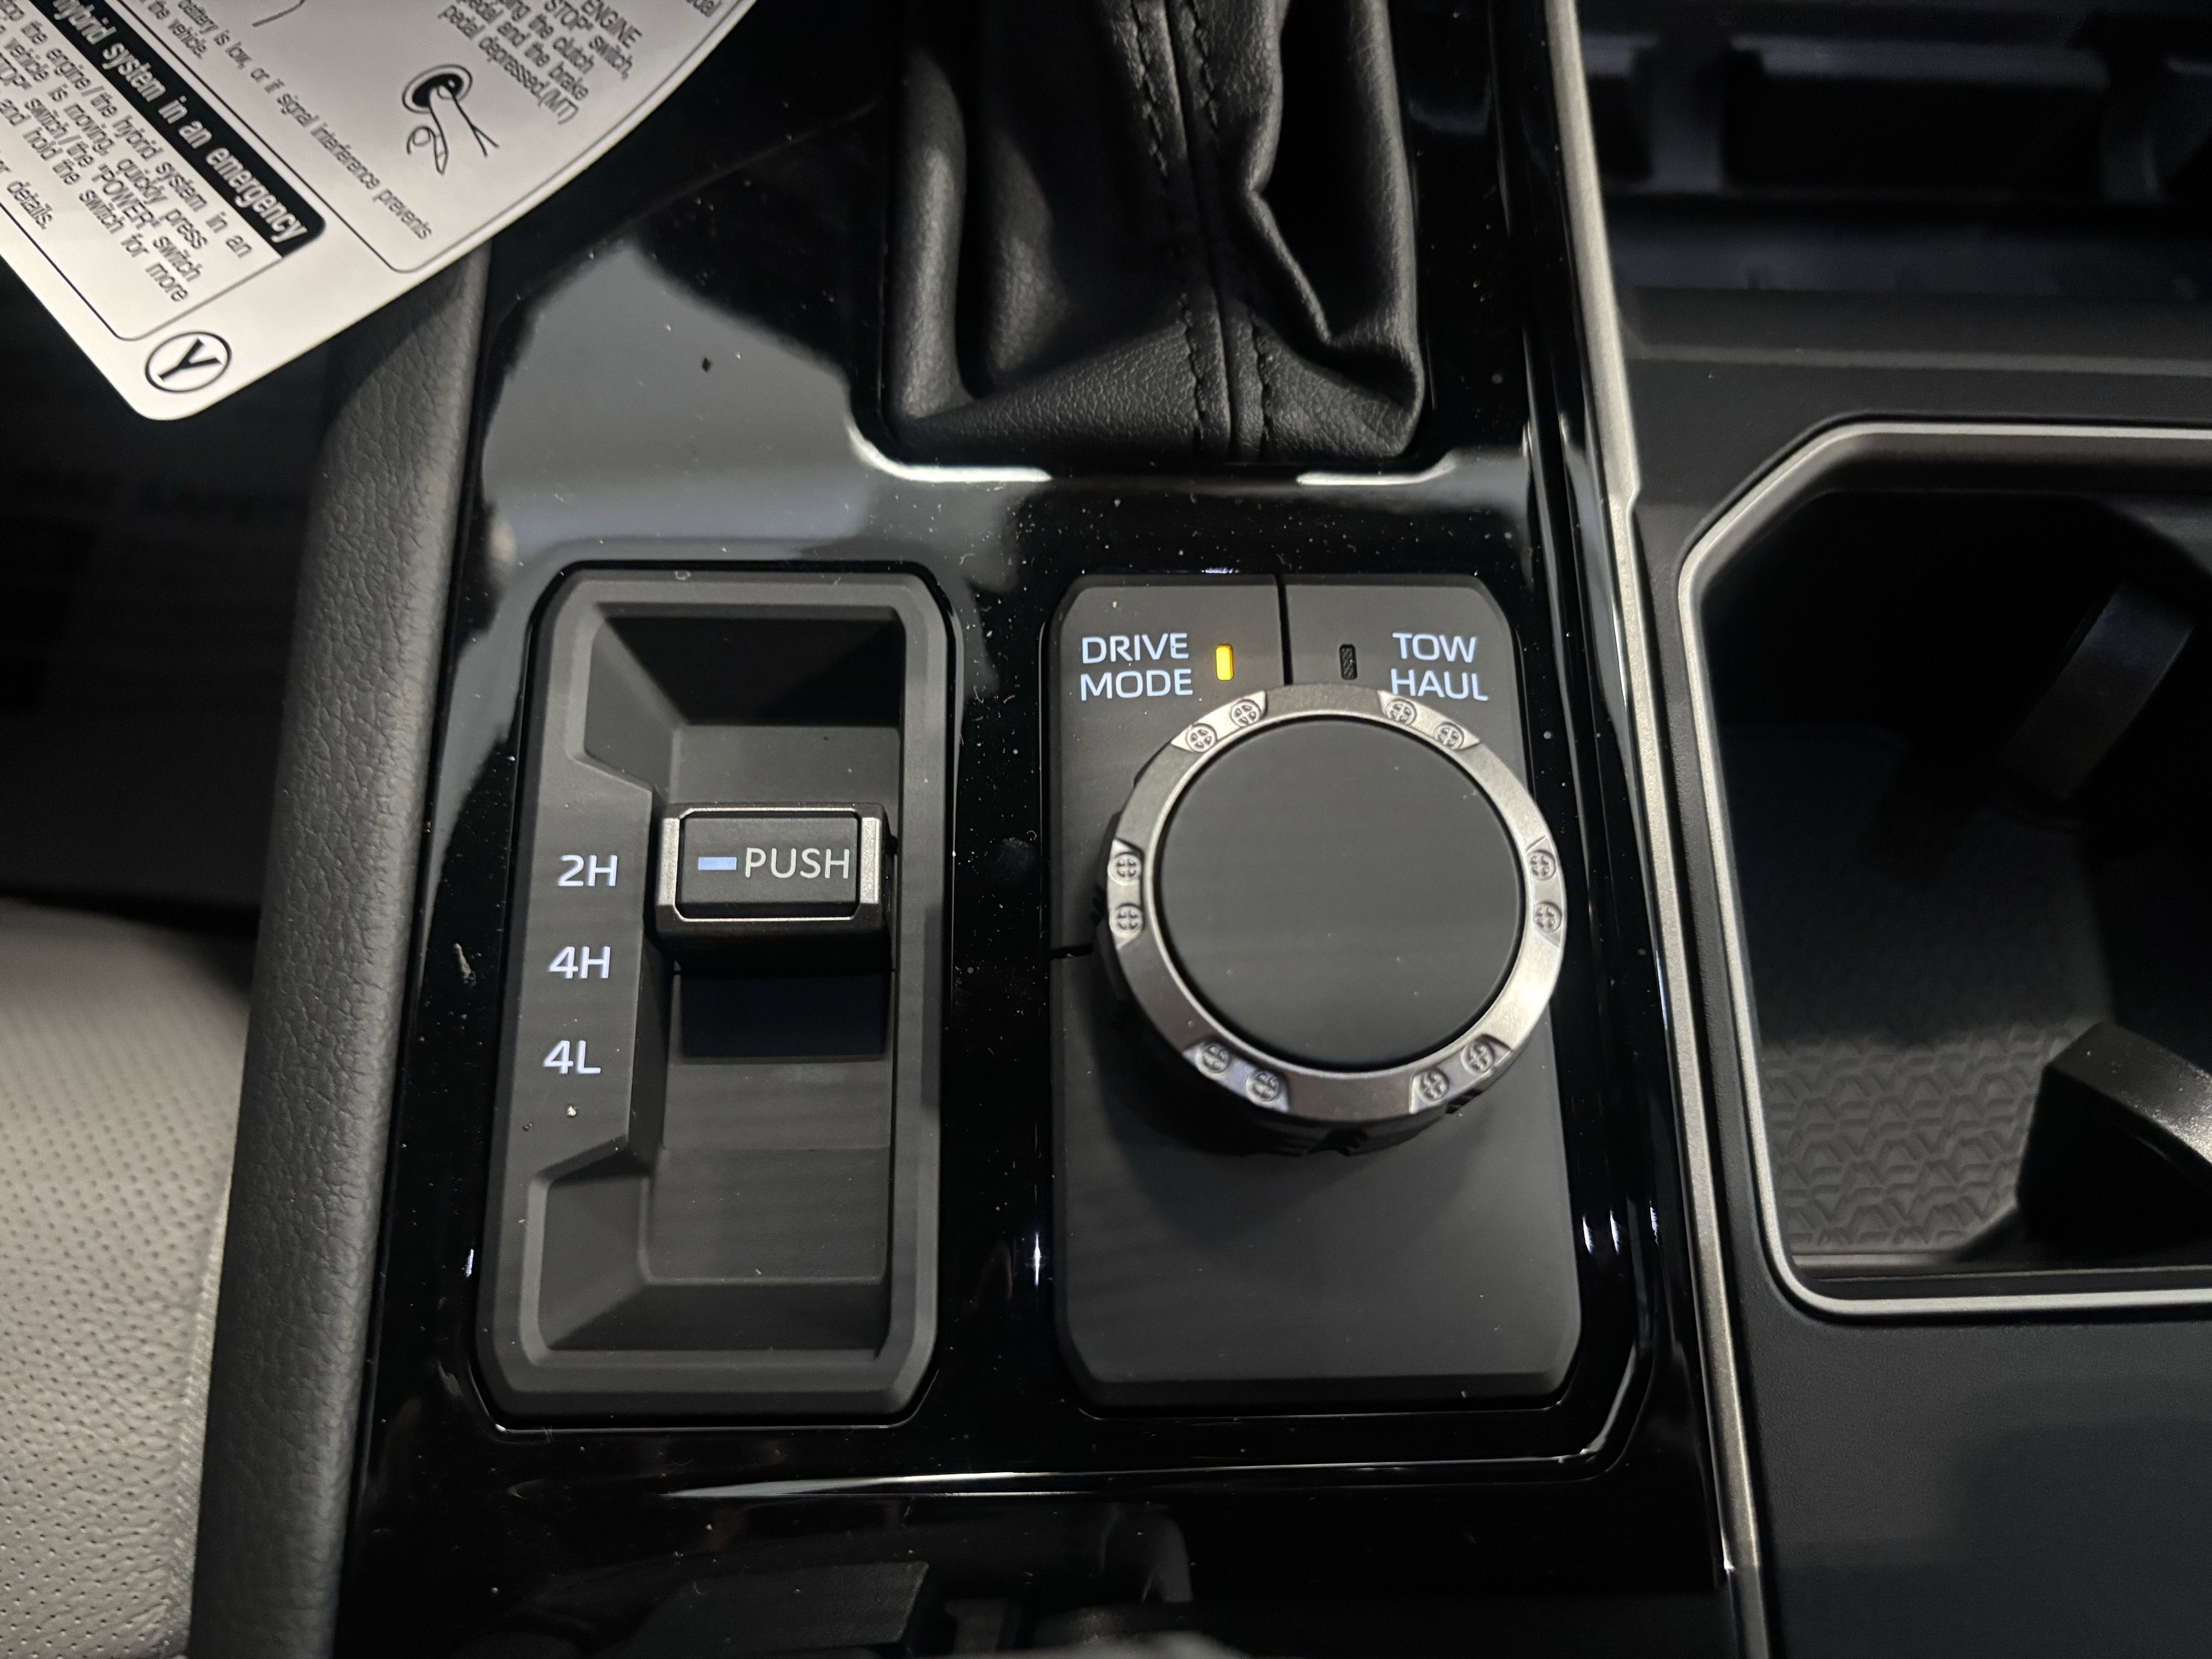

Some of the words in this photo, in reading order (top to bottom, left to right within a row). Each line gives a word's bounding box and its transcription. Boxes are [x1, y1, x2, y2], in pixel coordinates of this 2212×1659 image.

[168, 19, 207, 59] vehicle.
[438, 5, 486, 39] pedal
[528, 14, 554, 39] the
[552, 37, 594, 75] clutch
[582, 0, 643, 49] ENGINE
[457, 0, 503, 23] edal
[497, 21, 531, 47] and
[524, 41, 550, 67] the
[548, 61, 589, 101] brake
[588, 35, 633, 81] switch,
[3, 38, 50, 83] vehicle
[47, 82, 69, 102] is
[63, 102, 115, 156] moving,
[115, 158, 169, 204] quickly
[158, 208, 209, 250] press
[21, 20, 48, 45] the
[112, 115, 165, 161] hybrid
[155, 161, 208, 213] system
[205, 211, 228, 234] in
[225, 235, 253, 259] an
[102, 43, 166, 103] system
[158, 95, 188, 124] in
[179, 120, 213, 149] an
[206, 147, 307, 243] emergency
[214, 29, 230, 46] is
[225, 41, 252, 70] low,
[250, 68, 270, 83] or
[264, 78, 286, 94] if
[276, 93, 320, 129] signal
[310, 123, 381, 190] interference
[372, 188, 433, 240] prevents
[0, 98, 31, 126] and
[22, 126, 64, 161] hold
[52, 158, 81, 185] the
[79, 189, 125, 235] switch
[120, 233, 150, 258] for
[145, 262, 189, 302] more
[7, 180, 53, 230] details.
[91, 163, 161, 230] "POWER"
[153, 235, 203, 283] switch
[156, 338, 222, 382] Y
[1082, 632, 1190, 664] DRIVE
[1392, 632, 1479, 663] TOW
[1080, 668, 1194, 701] MODE
[1390, 668, 1489, 702] HAUL
[557, 854, 618, 887] 2H
[744, 847, 850, 880] PUSH
[548, 946, 611, 979] 4H
[543, 1040, 601, 1075] 4L
